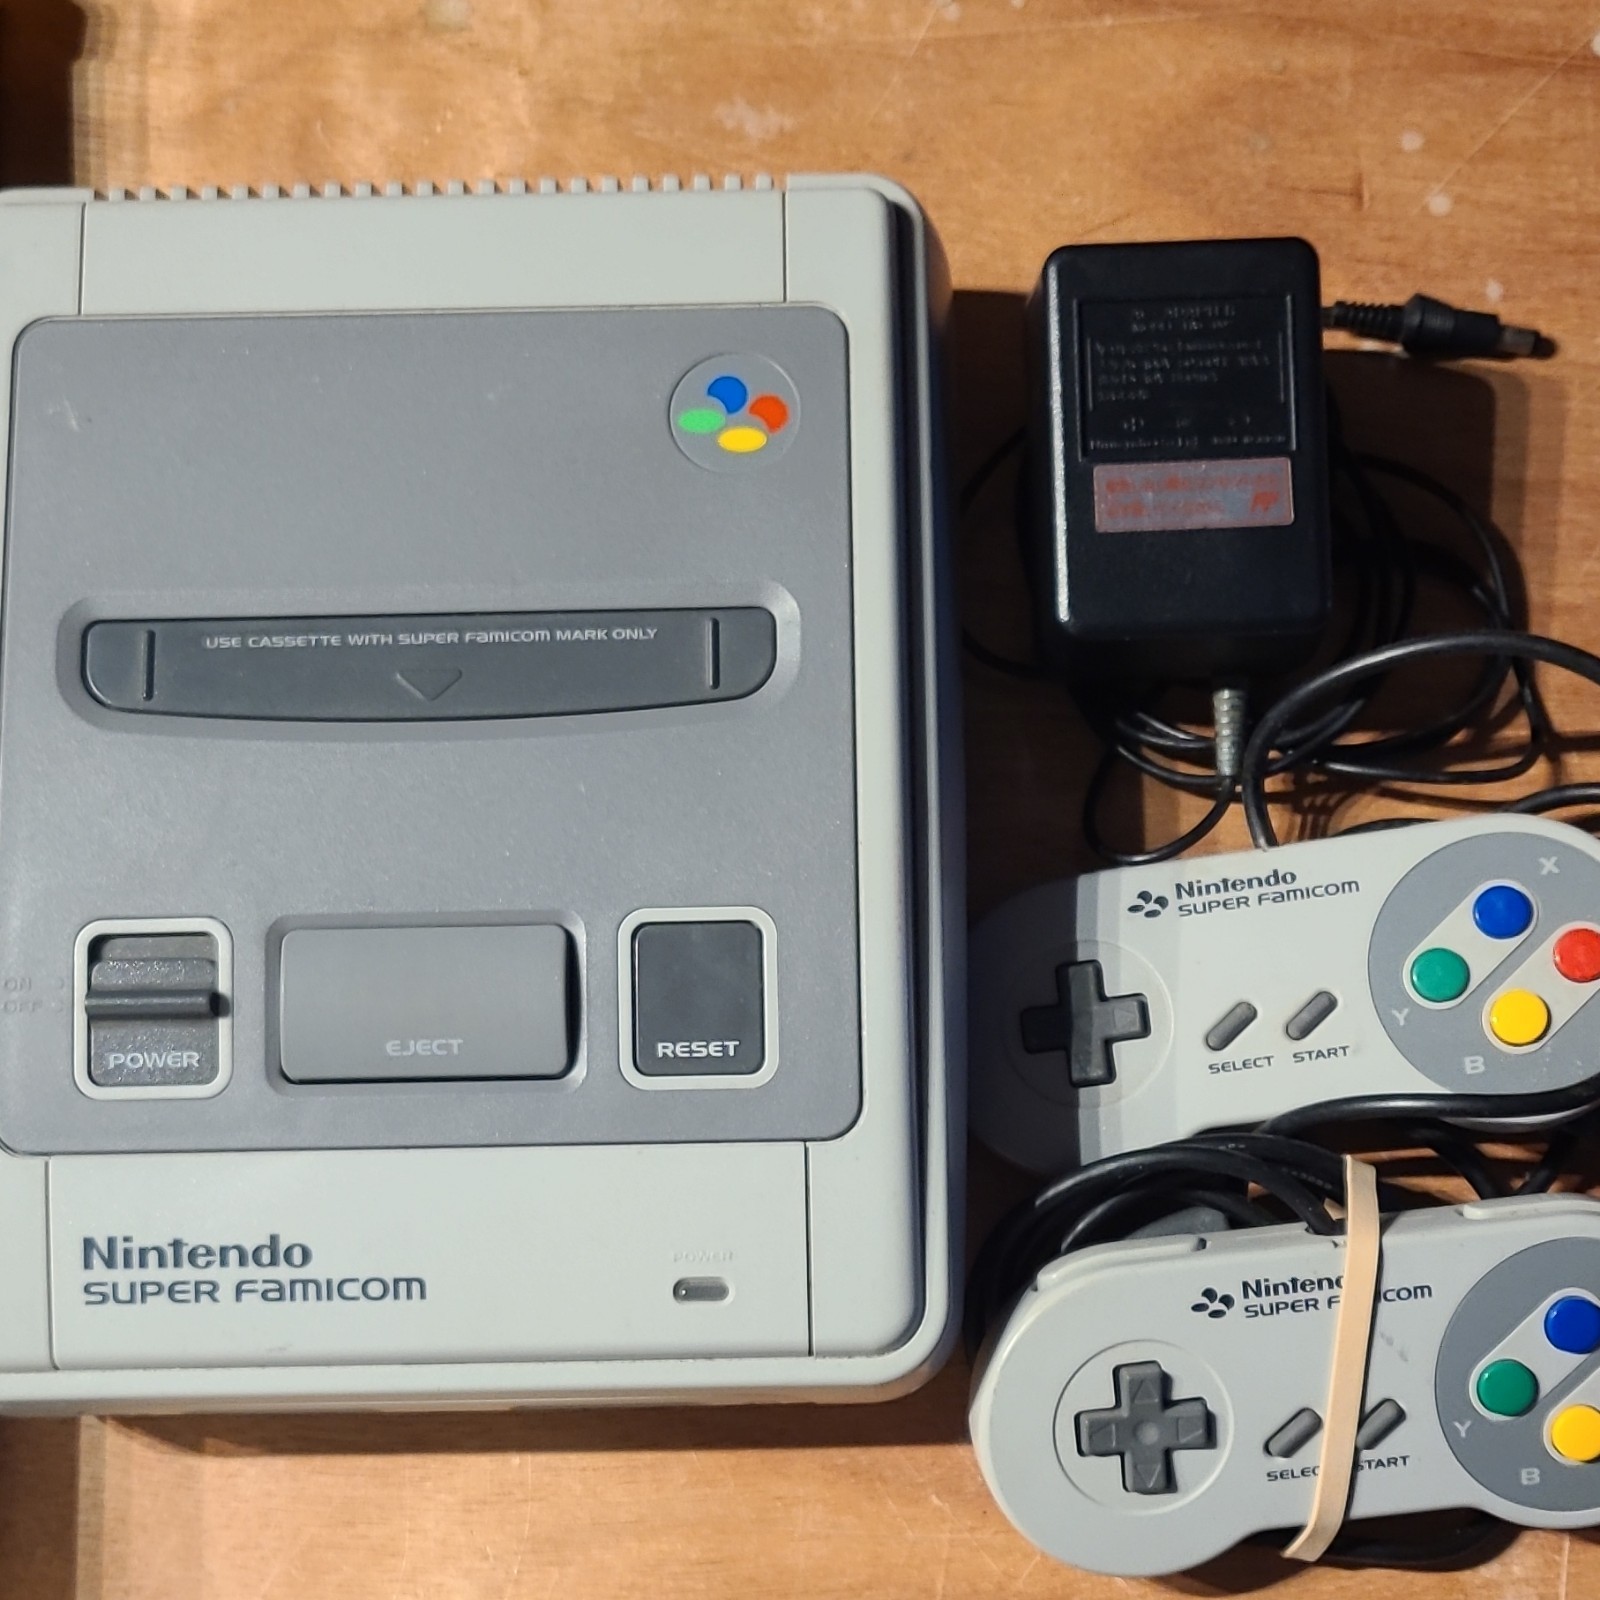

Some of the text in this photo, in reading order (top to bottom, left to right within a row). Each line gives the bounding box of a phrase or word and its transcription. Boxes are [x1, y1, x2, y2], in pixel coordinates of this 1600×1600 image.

[205, 635, 242, 649] USE
[247, 634, 342, 648] CASSETTE
[348, 633, 393, 646] WITH
[397, 632, 460, 645] SUPER
[556, 628, 608, 641] MARK
[612, 627, 659, 641] ONLY
[1538, 856, 1561, 876] X
[1175, 868, 1298, 900] Nintendo
[1178, 896, 1251, 917] SUPER
[1391, 1007, 1410, 1026] Y
[385, 1038, 464, 1057] EJECT
[656, 1040, 741, 1059] RESET
[1292, 1045, 1350, 1063] START
[107, 1051, 201, 1069] POWER
[1208, 1055, 1275, 1075] SELECT
[1464, 1055, 1486, 1075] B
[82, 1233, 314, 1271] Nintendo
[83, 1280, 222, 1306] SUPER
[1243, 1297, 1320, 1319] SUPER
[1453, 1420, 1472, 1438] Y
[1266, 1464, 1321, 1482] SELEC
[1520, 1467, 1541, 1486] B
